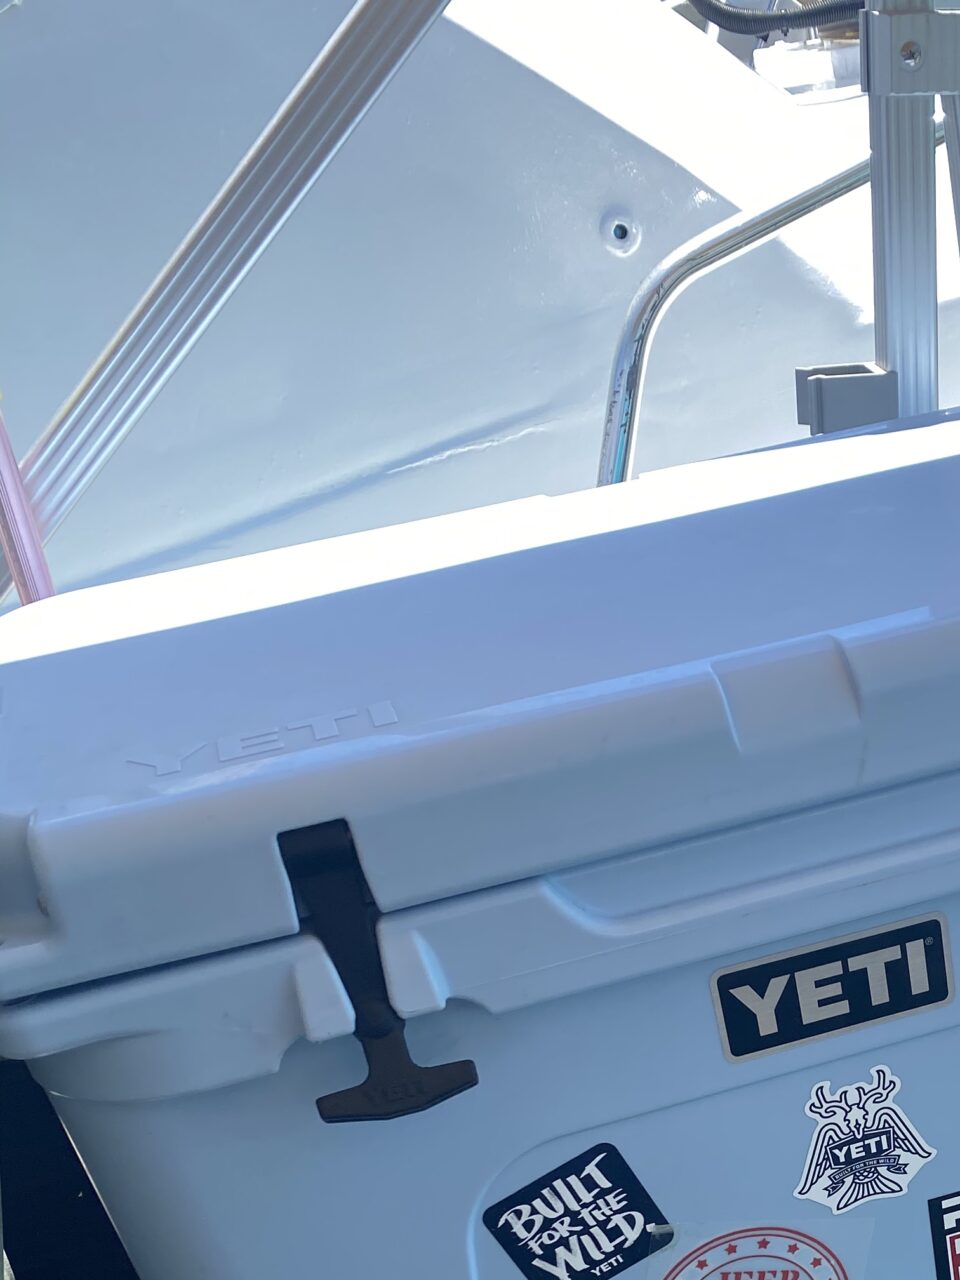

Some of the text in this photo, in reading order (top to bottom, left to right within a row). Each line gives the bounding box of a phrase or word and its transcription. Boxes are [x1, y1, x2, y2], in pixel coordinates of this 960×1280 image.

[126, 701, 399, 776] YETI
[729, 937, 931, 1037] YETI
[832, 1134, 889, 1163] YETI
[497, 1152, 613, 1246] BUILT
[526, 1188, 628, 1255] FOR THE
[590, 1254, 624, 1277] YETI
